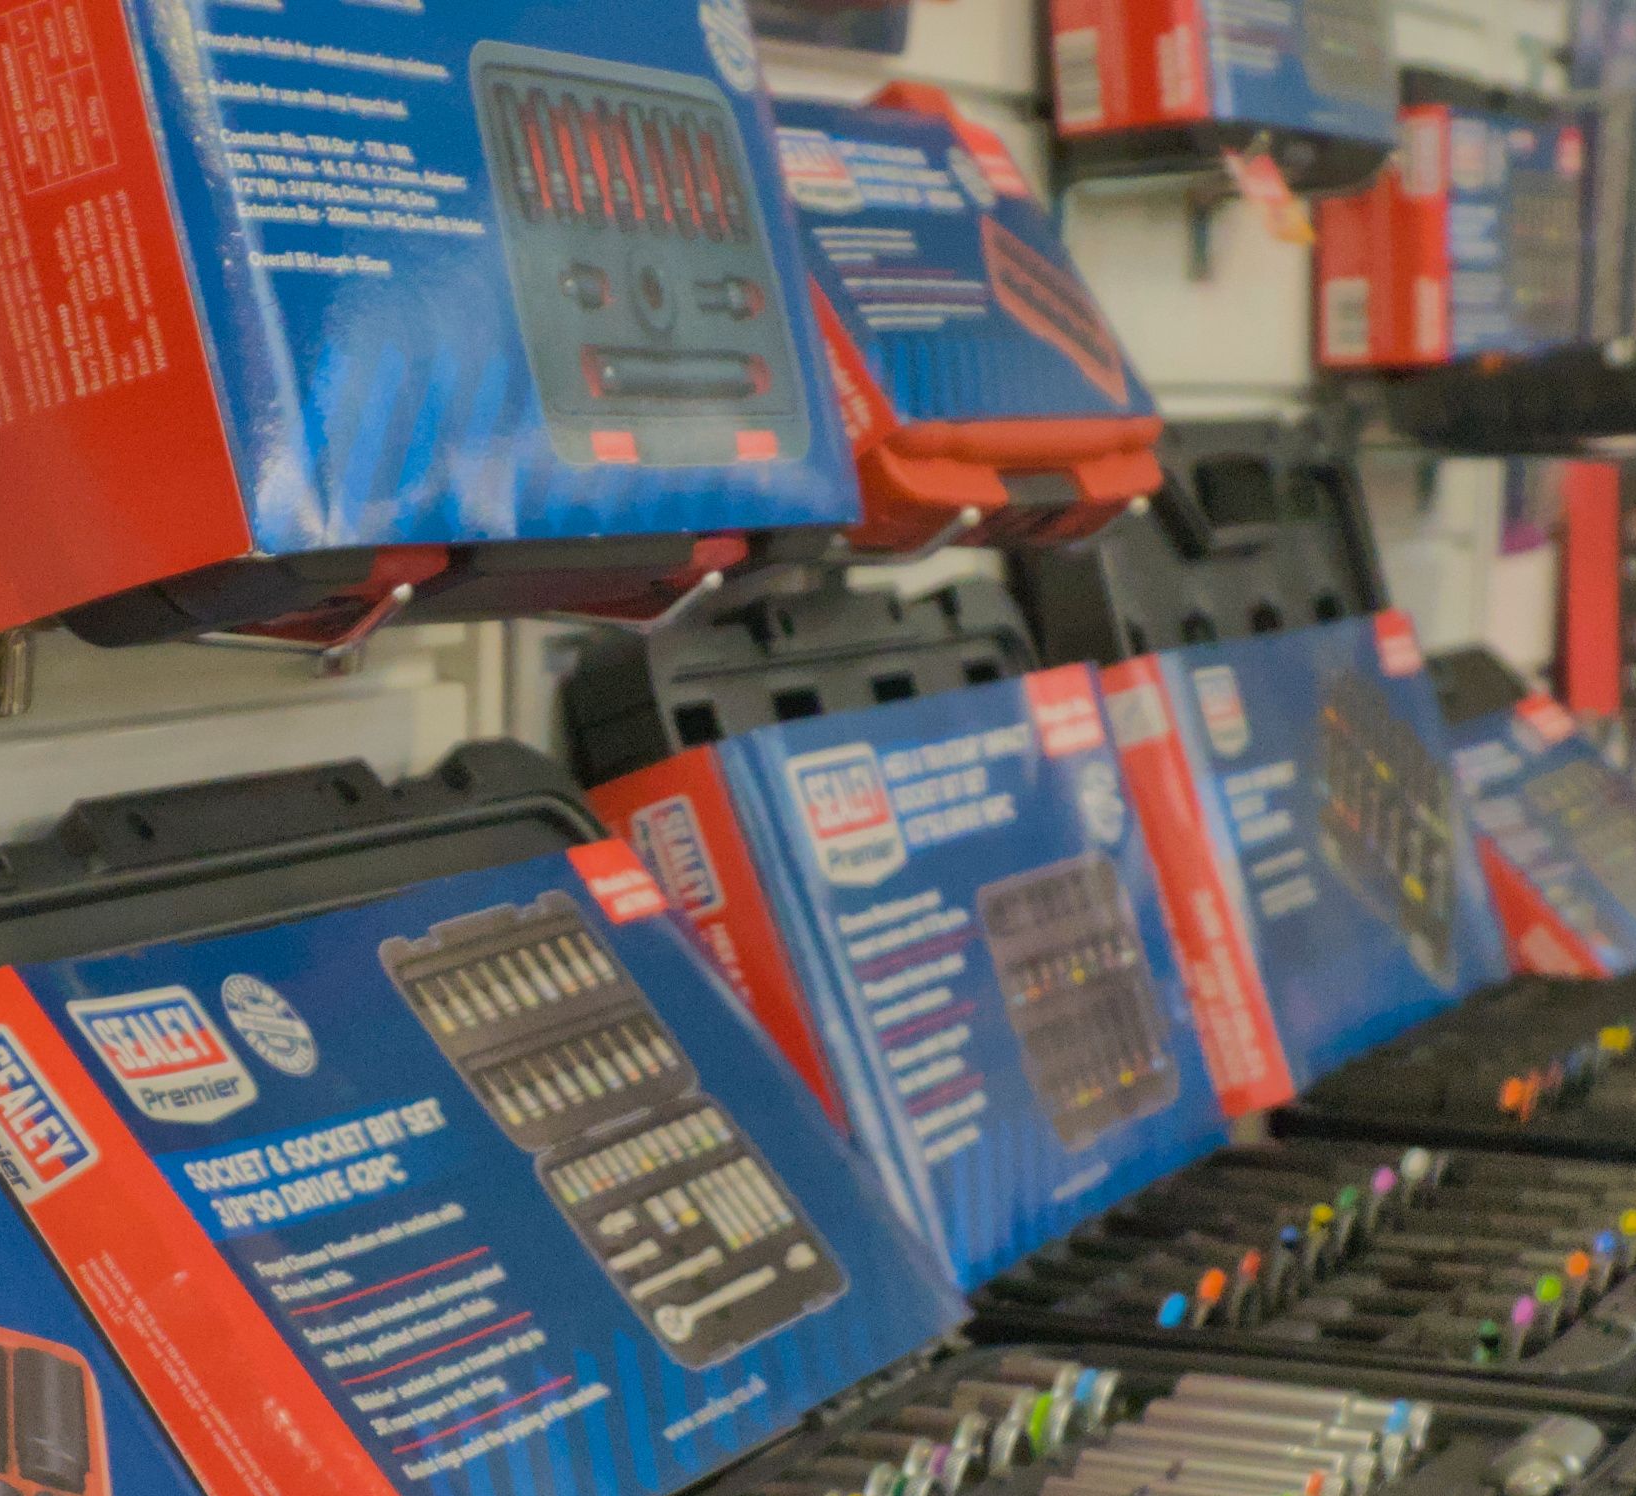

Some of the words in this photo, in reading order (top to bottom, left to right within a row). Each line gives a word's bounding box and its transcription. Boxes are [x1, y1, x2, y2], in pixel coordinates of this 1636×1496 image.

[26, 51, 47, 101] Recycle
[16, 113, 29, 133] UK
[56, 80, 80, 127] Weight
[114, 188, 152, 307] www.sealey.co.uk
[249, 250, 293, 271] Overall
[78, 259, 98, 302] 01284
[94, 254, 113, 296] 01284
[54, 301, 77, 348] Group
[65, 348, 89, 397] Sealey
[81, 341, 93, 358] St
[85, 358, 104, 390] Bury
[88, 1001, 216, 1075] SEALEY
[138, 1073, 243, 1115] Premier
[183, 1148, 273, 1195] SOCKET
[264, 1143, 290, 1175] &
[281, 1121, 371, 1172] SOCKET
[366, 1108, 408, 1145] BIT
[402, 1097, 449, 1137] SET
[279, 1167, 355, 1215] DRIVE
[345, 1153, 409, 1192] 42PC
